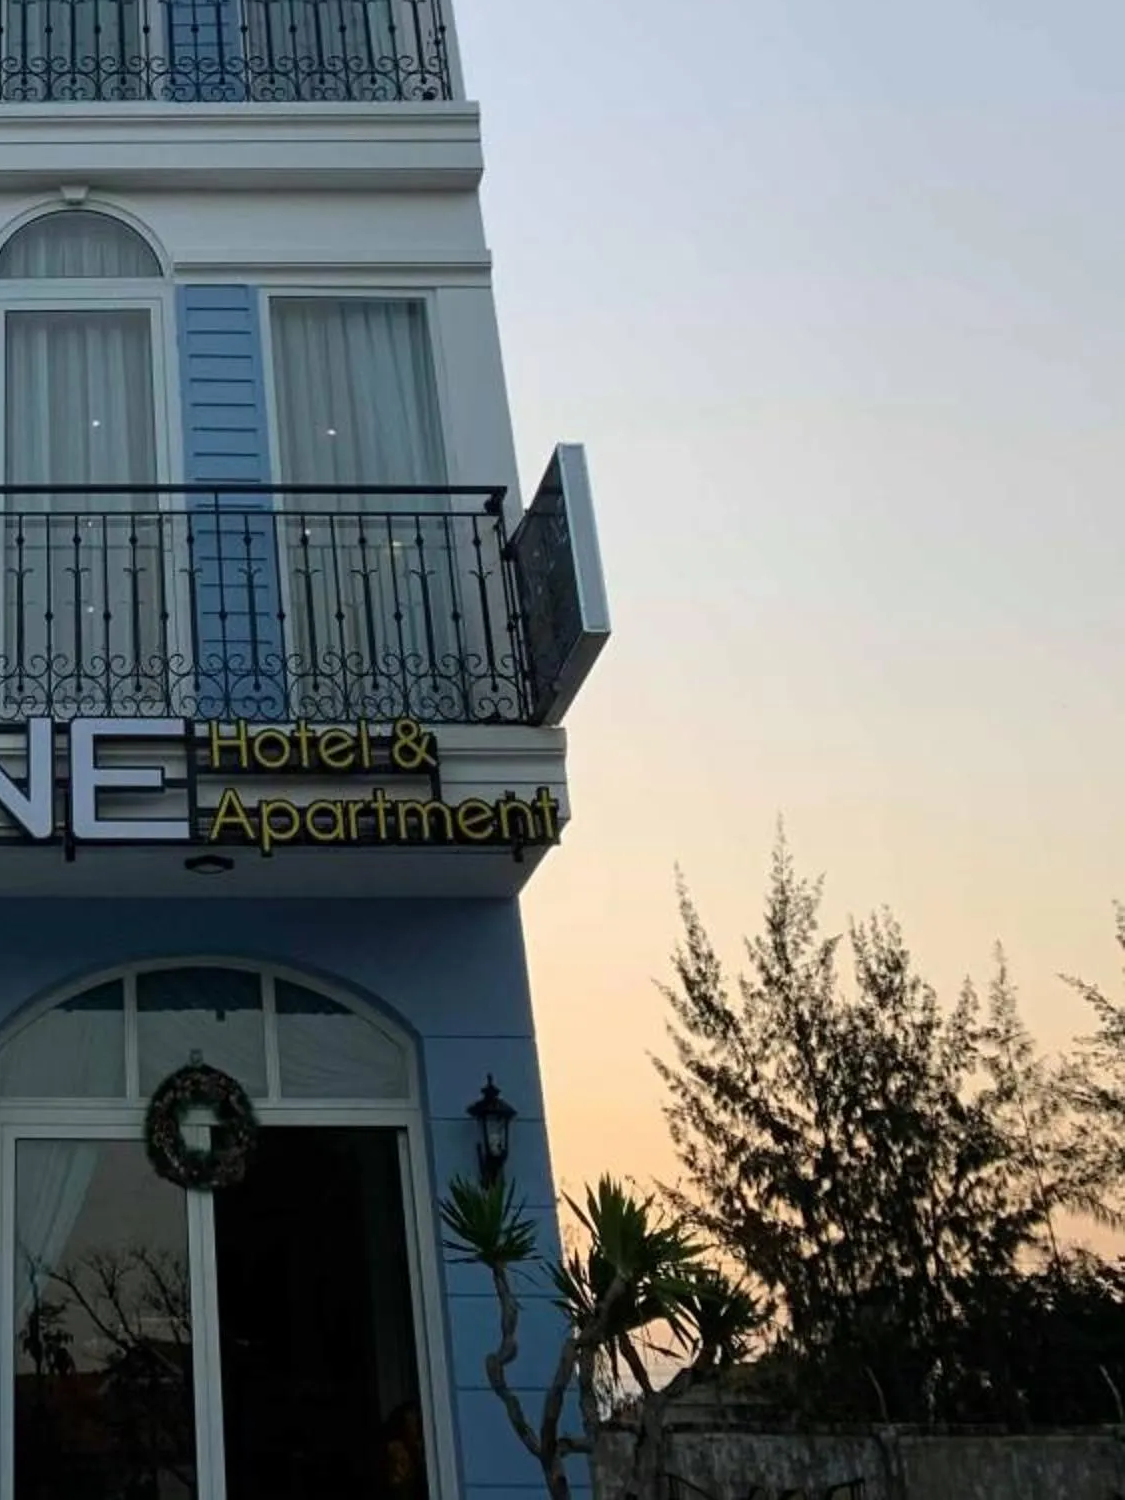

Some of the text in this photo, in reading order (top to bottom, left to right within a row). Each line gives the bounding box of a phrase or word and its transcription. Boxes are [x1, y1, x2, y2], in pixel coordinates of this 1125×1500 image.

[210, 718, 437, 769] Hotel &
[210, 787, 558, 852] Apartment
